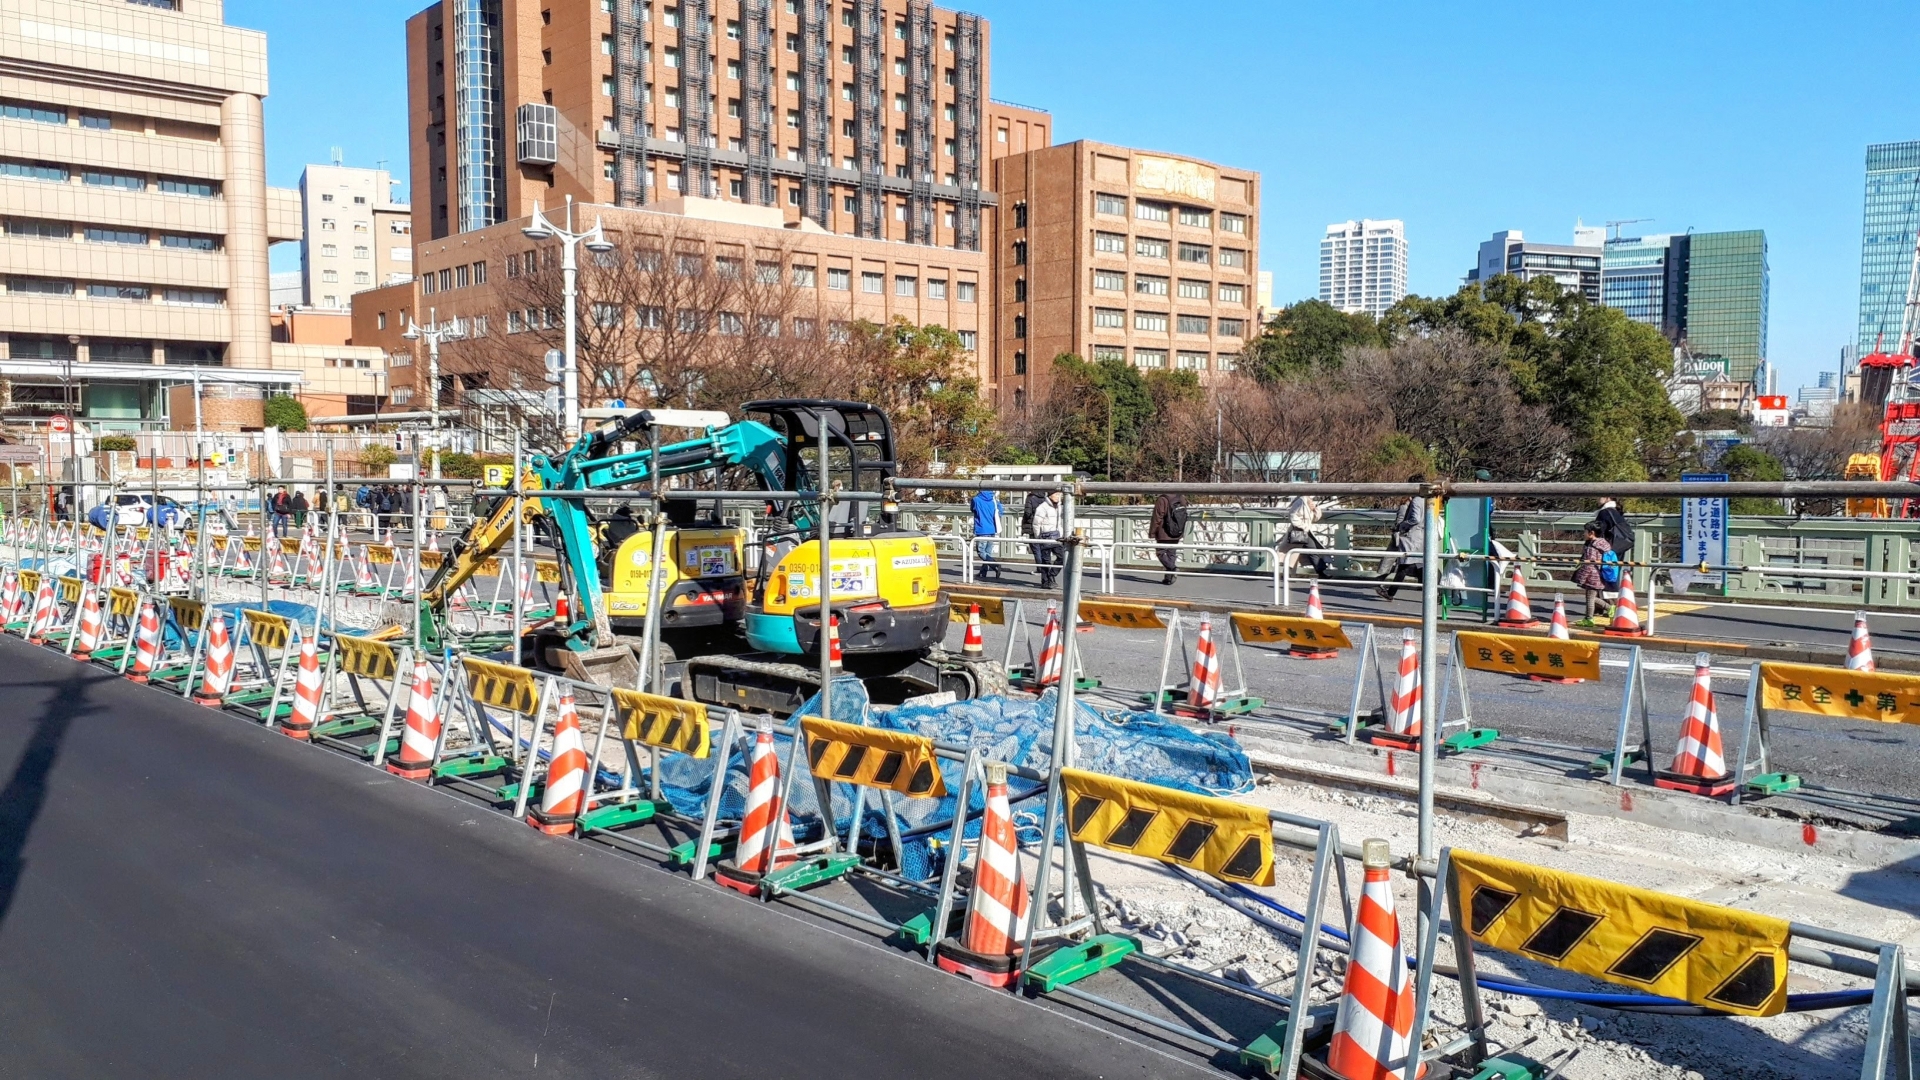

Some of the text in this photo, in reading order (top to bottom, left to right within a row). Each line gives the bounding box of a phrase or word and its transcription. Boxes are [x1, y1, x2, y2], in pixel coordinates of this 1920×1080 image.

[489, 468, 499, 481] P
[495, 504, 516, 532] YANM
[1710, 497, 1720, 540] と道路を
[1697, 497, 1707, 562] おしています
[789, 563, 820, 573] 0350-01
[702, 592, 733, 602] YANMAR
